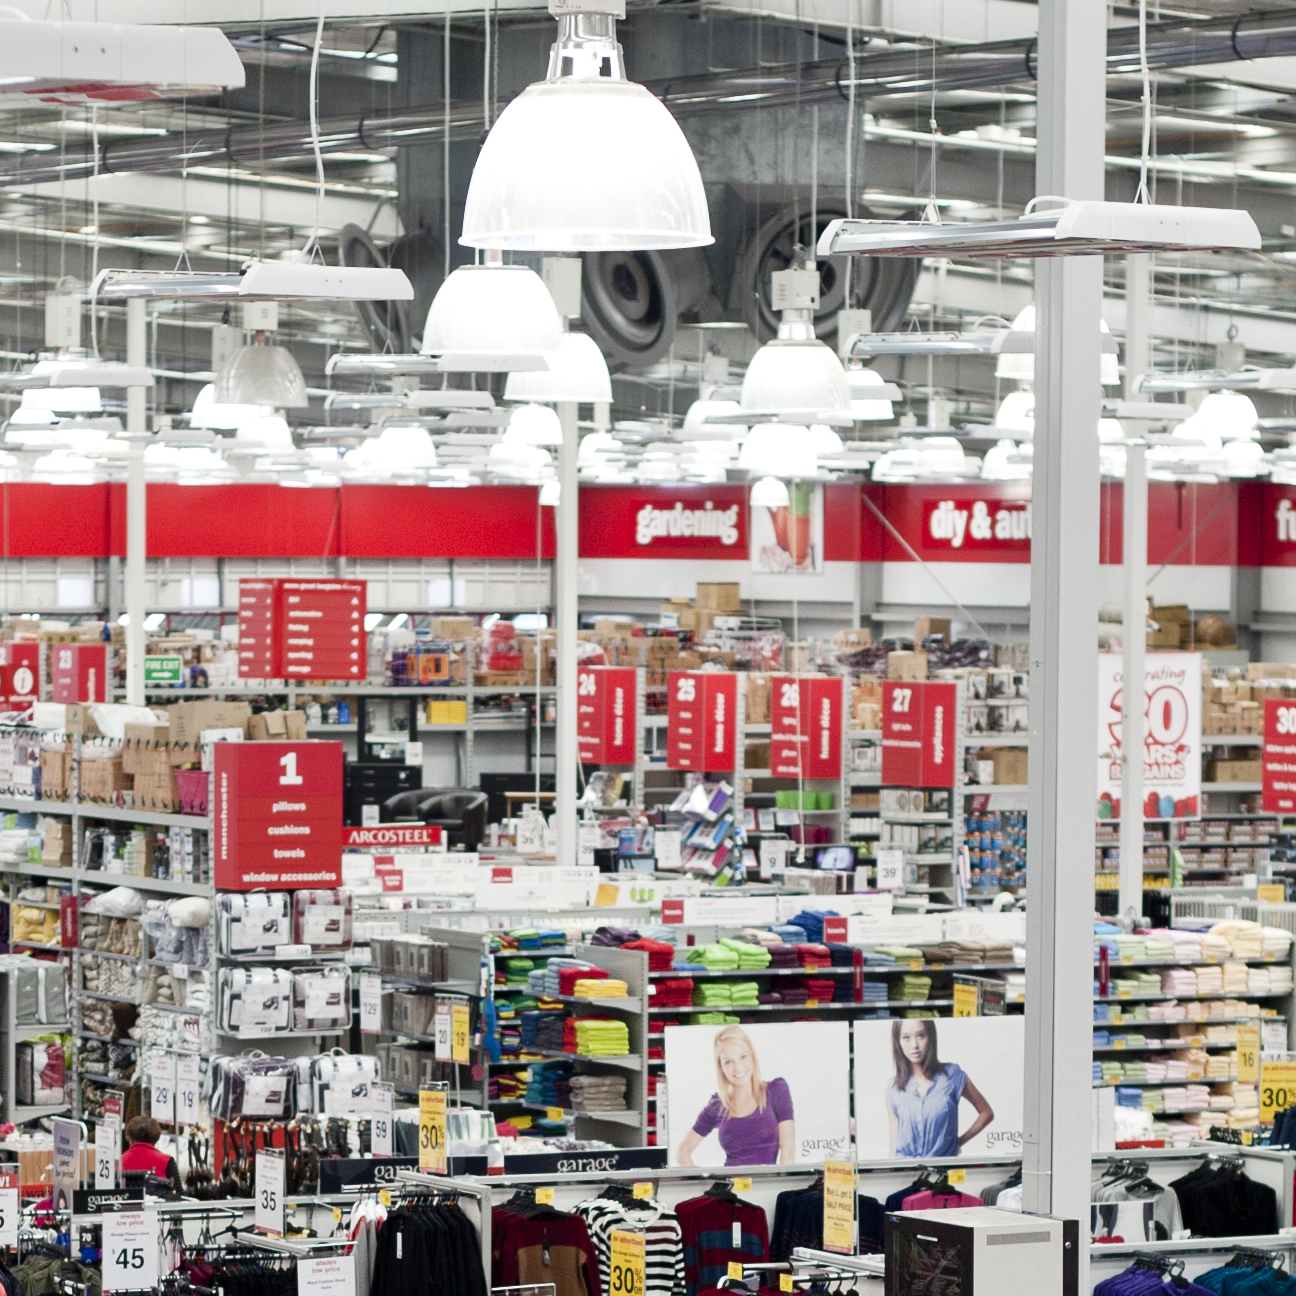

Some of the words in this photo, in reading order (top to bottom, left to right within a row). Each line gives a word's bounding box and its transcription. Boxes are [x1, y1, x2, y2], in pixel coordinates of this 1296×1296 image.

[637, 502, 739, 544] gardening
[931, 501, 967, 547] diy
[971, 502, 991, 538] &
[59, 650, 72, 668] 23
[145, 660, 163, 672] FIRE
[164, 660, 180, 672] EXIT
[578, 674, 595, 695] 24
[678, 679, 695, 700] 25
[892, 689, 911, 712] 27
[614, 716, 624, 745] home
[279, 752, 303, 784] 1
[273, 801, 306, 812] pillows
[268, 825, 310, 835] cushions
[349, 828, 431, 843] ARCOSTEEL
[274, 848, 304, 858] towels
[243, 872, 278, 882] window
[280, 872, 336, 882] accessories
[802, 1137, 843, 1156] garage
[558, 1156, 616, 1174] garage
